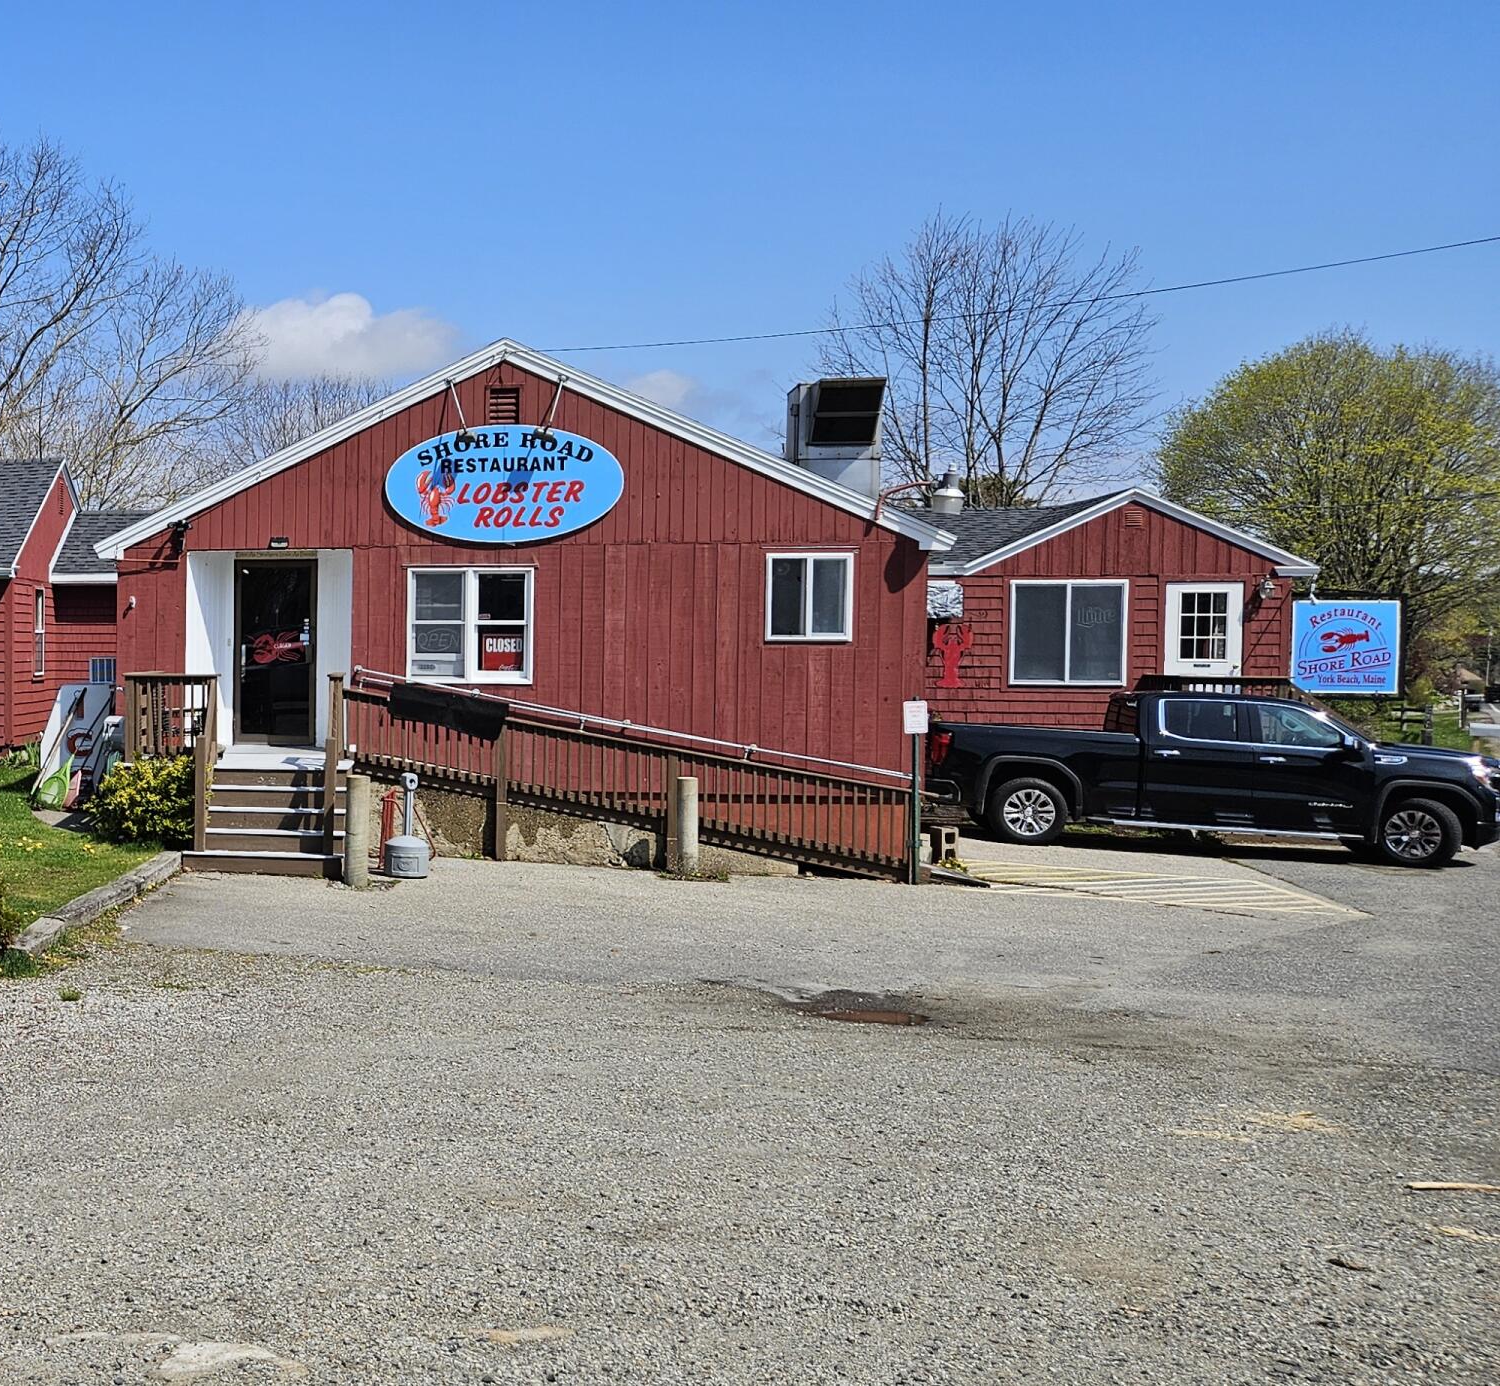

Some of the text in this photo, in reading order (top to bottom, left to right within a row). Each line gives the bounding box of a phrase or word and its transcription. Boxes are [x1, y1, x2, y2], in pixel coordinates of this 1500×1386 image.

[417, 432, 594, 467] SHORE ROAD
[440, 456, 568, 474] RESTAURANT
[457, 481, 585, 505] LOBSTER
[473, 506, 564, 529] ROLLS
[1309, 608, 1382, 630] Restaurant
[417, 632, 460, 648] OPEN
[485, 637, 523, 653] CLOSED
[1297, 651, 1391, 676] SHORE ROAD
[1317, 674, 1386, 685] York Beach, Maine
